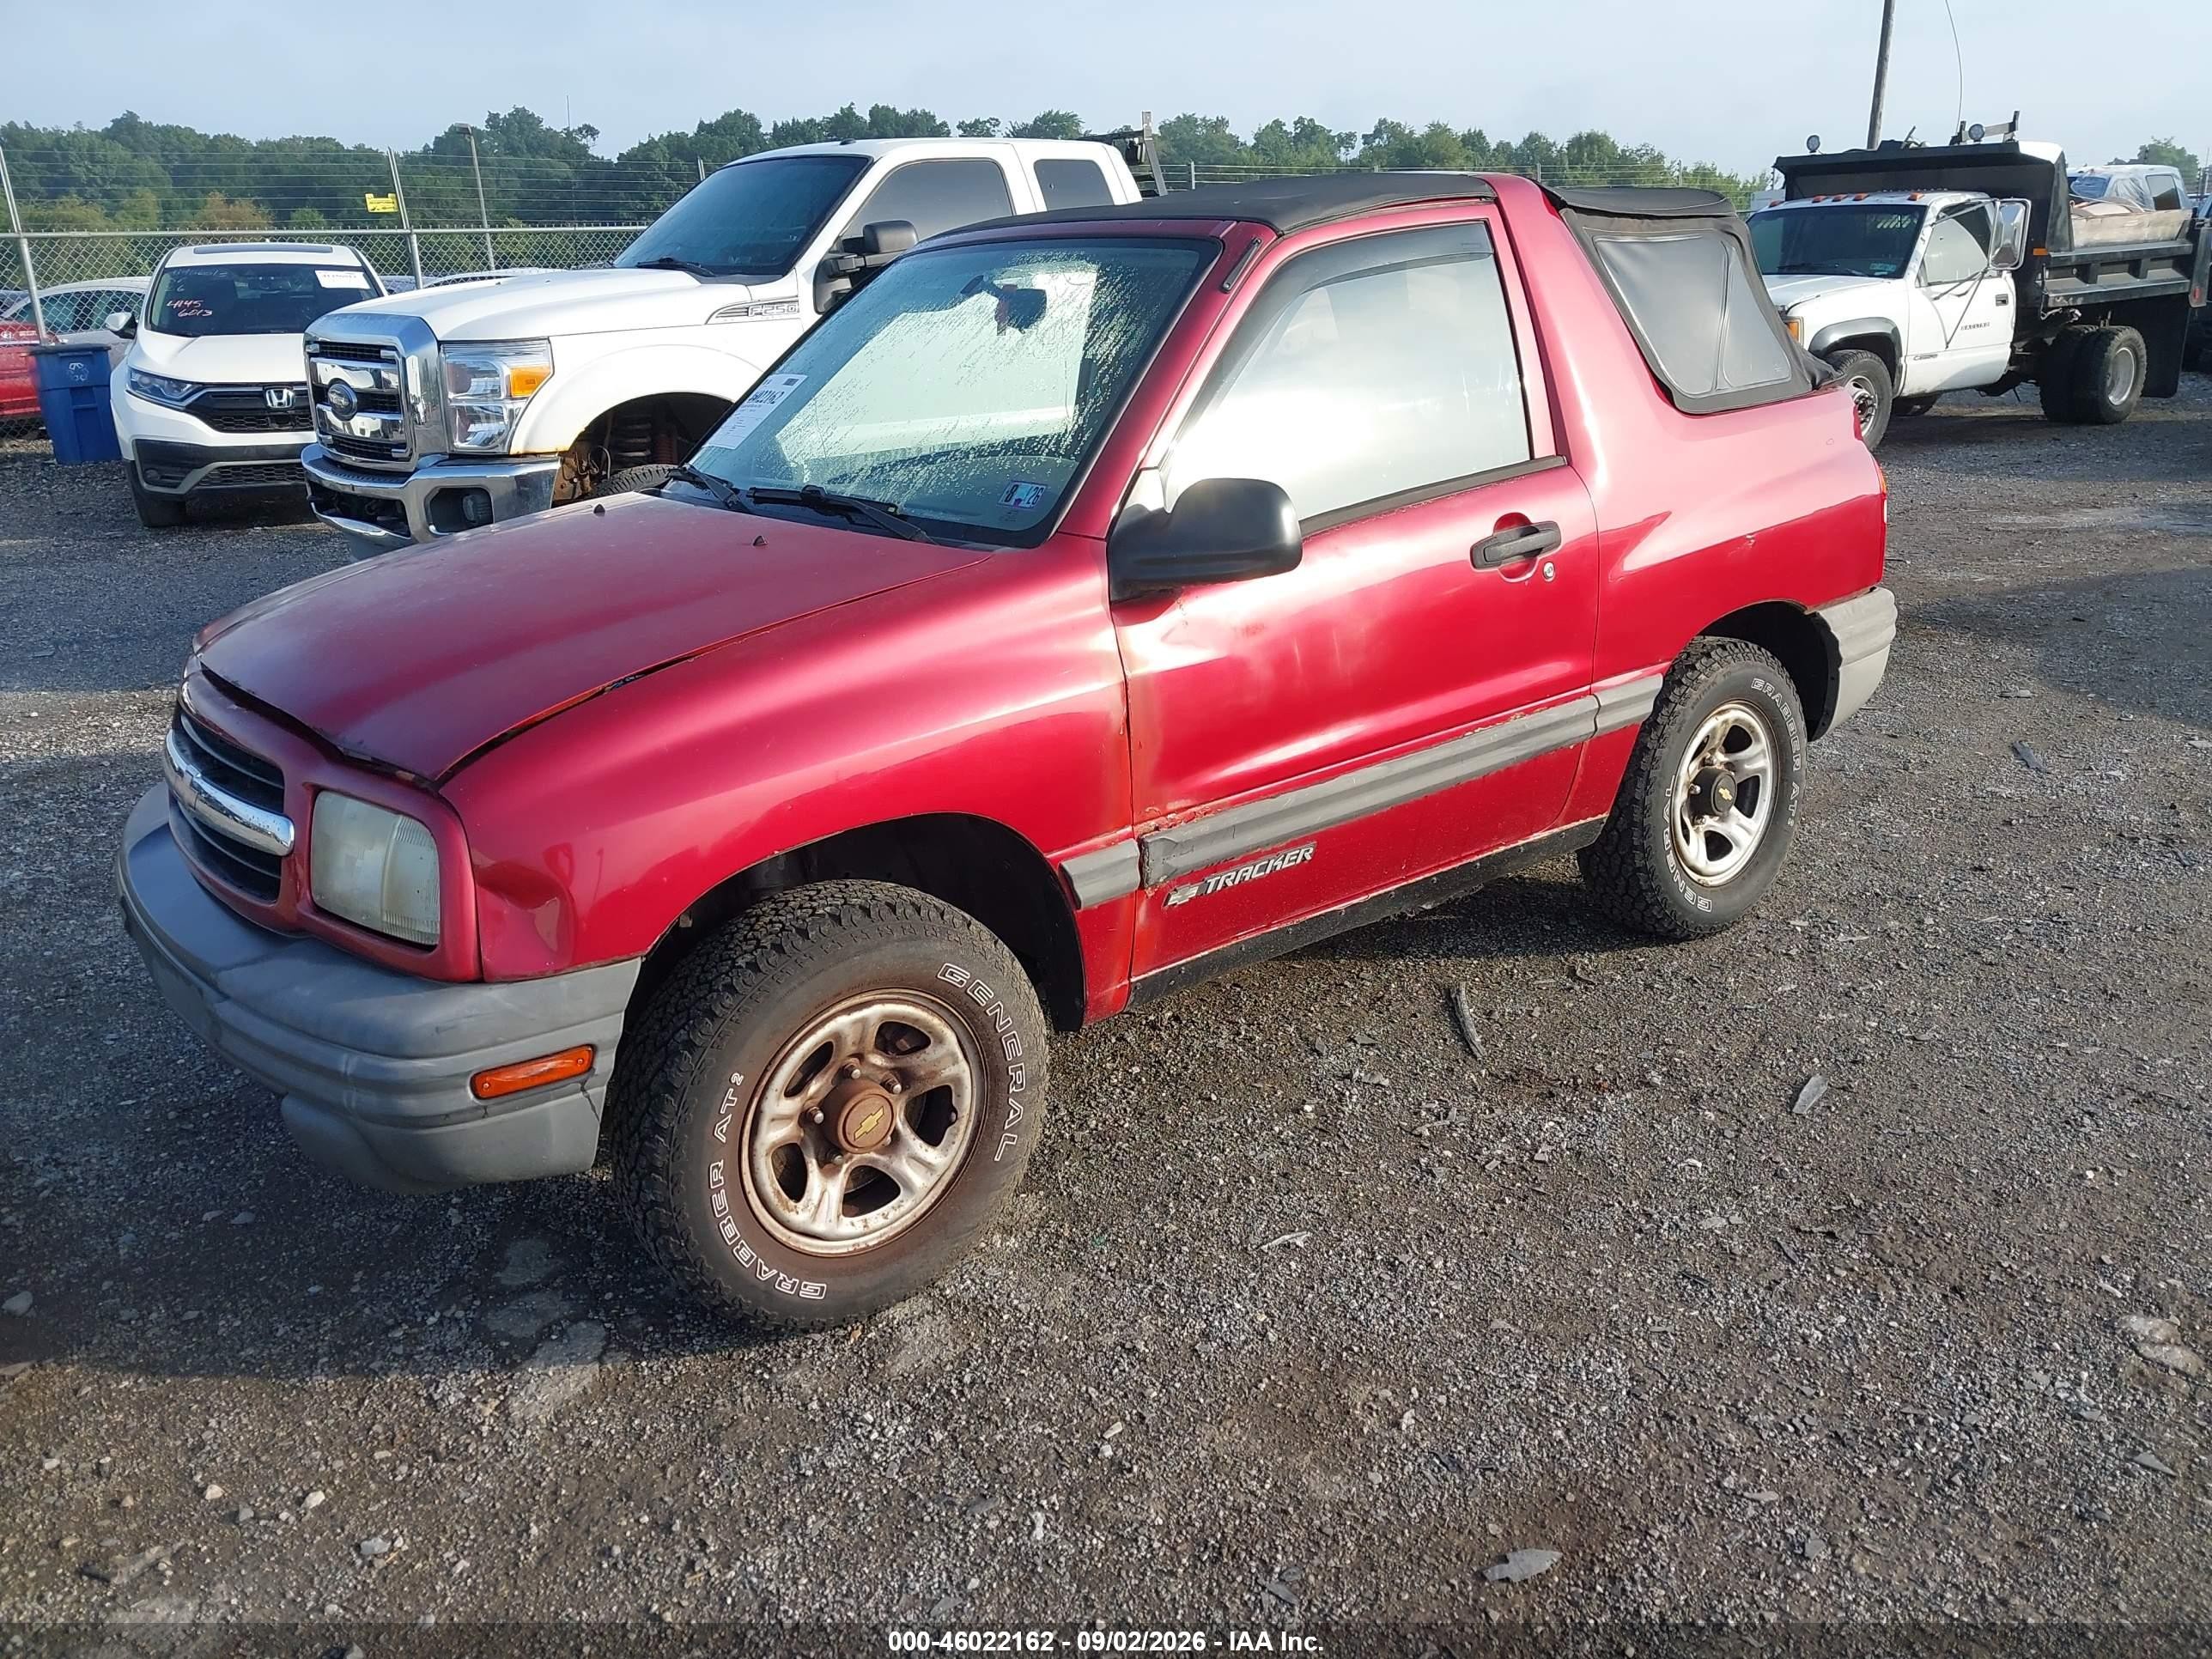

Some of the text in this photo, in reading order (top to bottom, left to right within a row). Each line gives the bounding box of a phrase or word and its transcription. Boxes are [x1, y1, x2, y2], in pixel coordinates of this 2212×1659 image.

[1750, 678, 1802, 771] GRABBER
[1204, 844, 1316, 895] TRACKER
[1662, 775, 1713, 913] GENERAL
[936, 963, 1028, 1163] GENERAL
[708, 1158, 828, 1301] GRABBER
